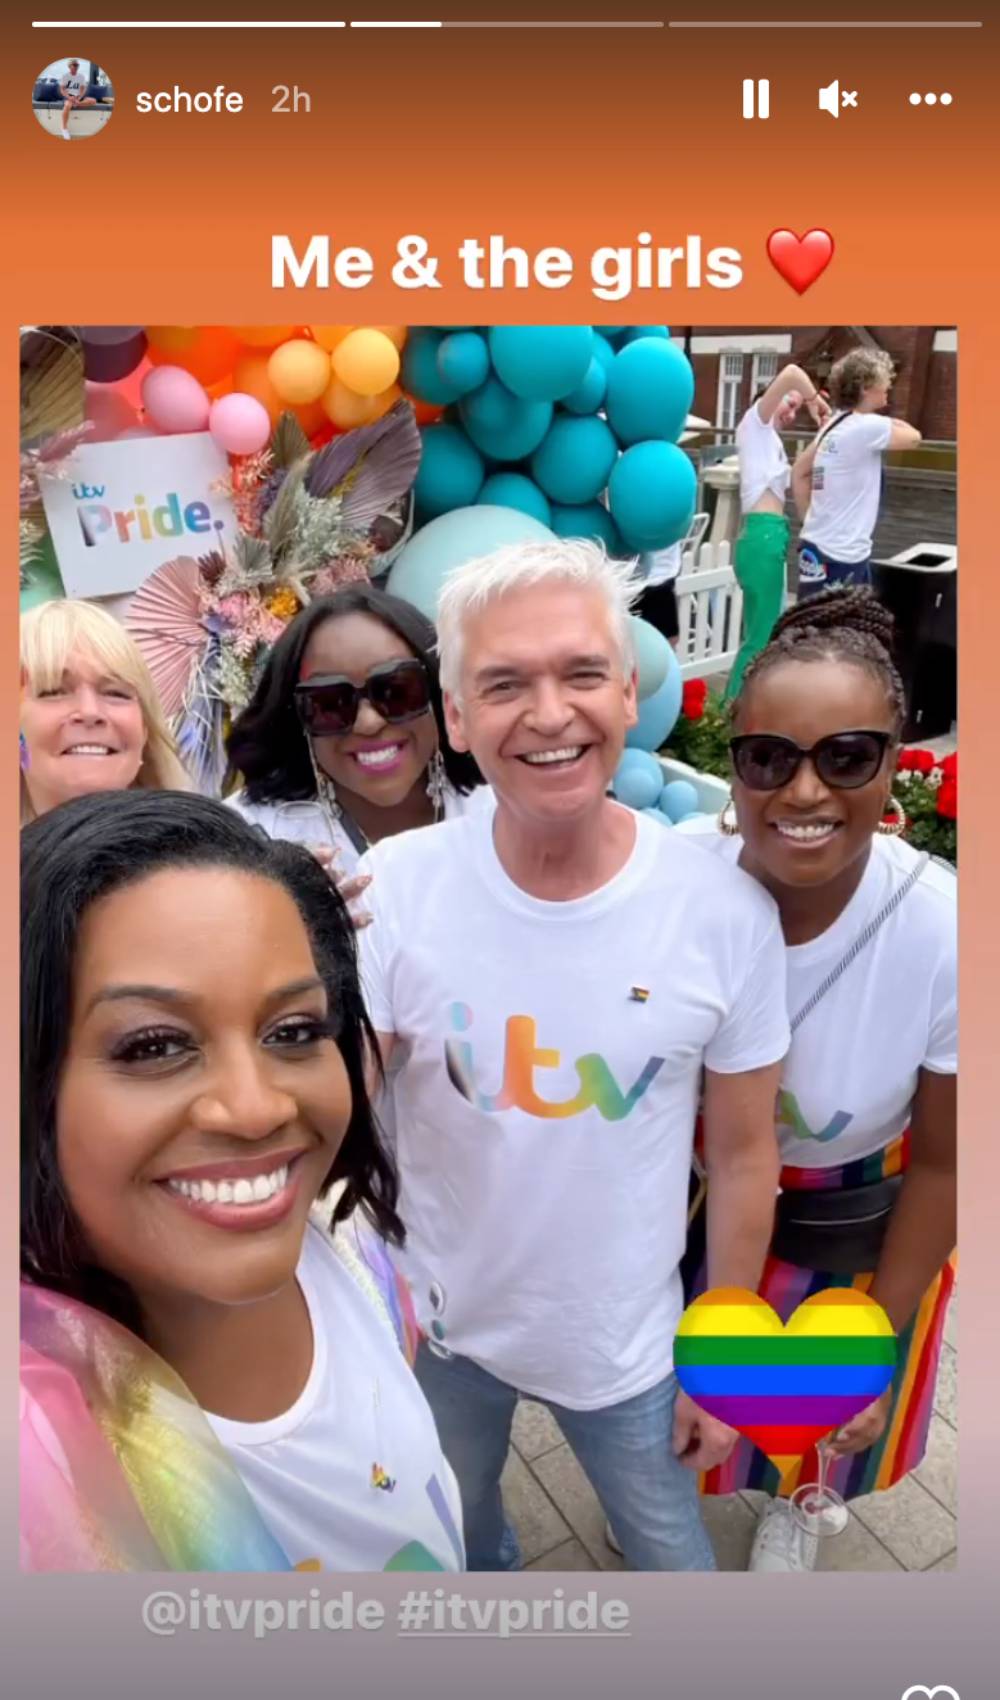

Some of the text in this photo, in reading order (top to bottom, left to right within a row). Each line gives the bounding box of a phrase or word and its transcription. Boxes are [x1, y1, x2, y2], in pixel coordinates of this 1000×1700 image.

[72, 483, 105, 499] itv
[77, 492, 225, 547] Pride.
[444, 1001, 666, 1122] itv
